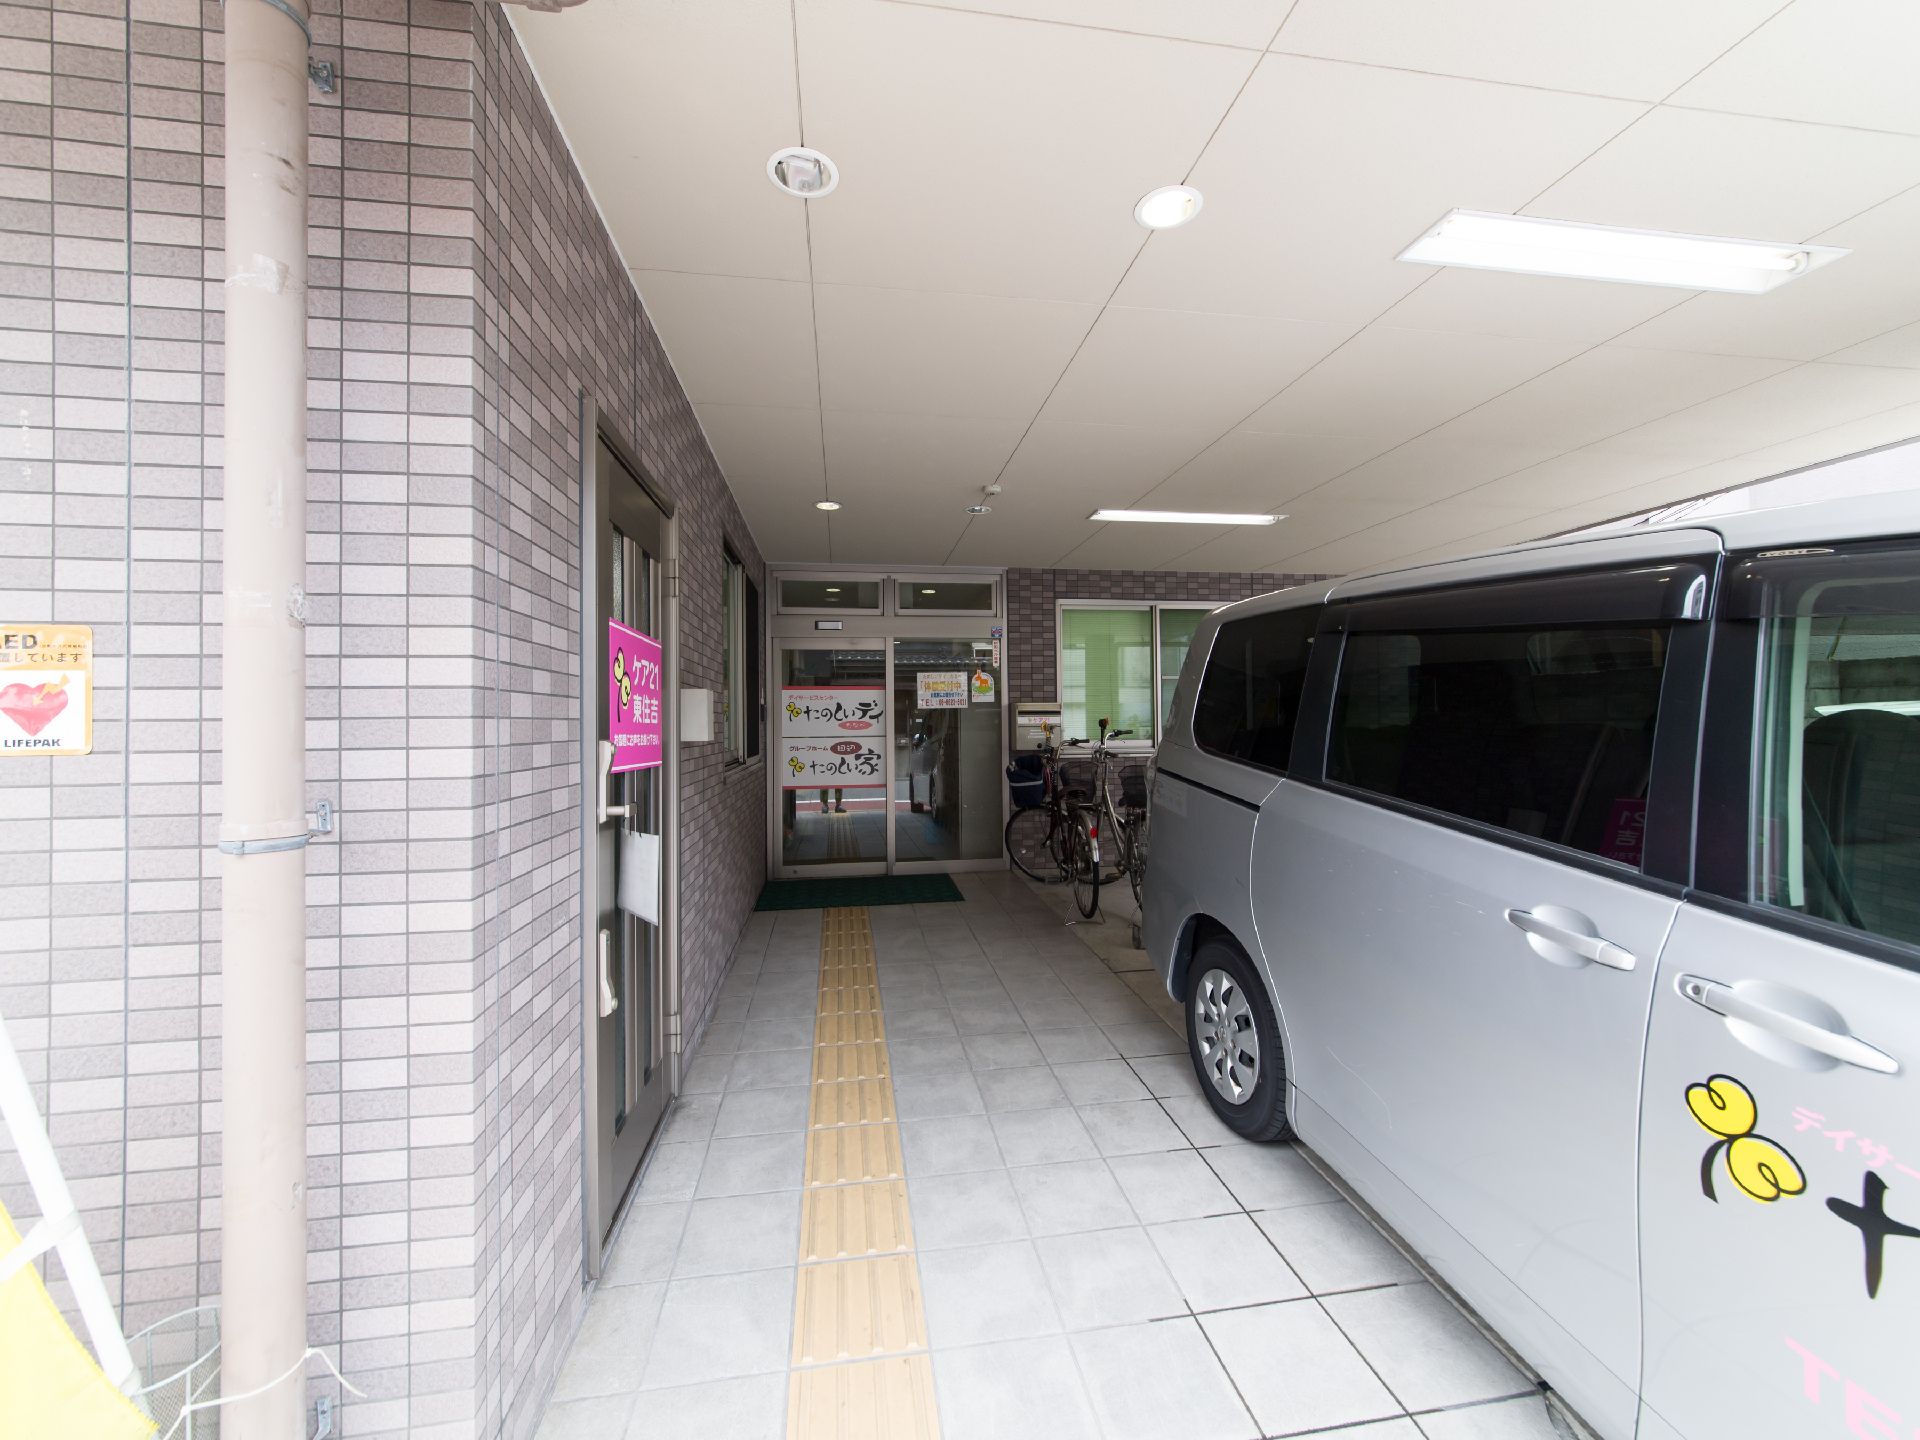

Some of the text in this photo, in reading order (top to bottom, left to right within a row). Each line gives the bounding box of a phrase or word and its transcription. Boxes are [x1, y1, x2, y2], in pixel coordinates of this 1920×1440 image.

[0, 633, 38, 650] ED
[632, 653, 659, 691] ケア21
[632, 694, 659, 724] 東住吉
[4, 738, 61, 748] LIFEPAK
